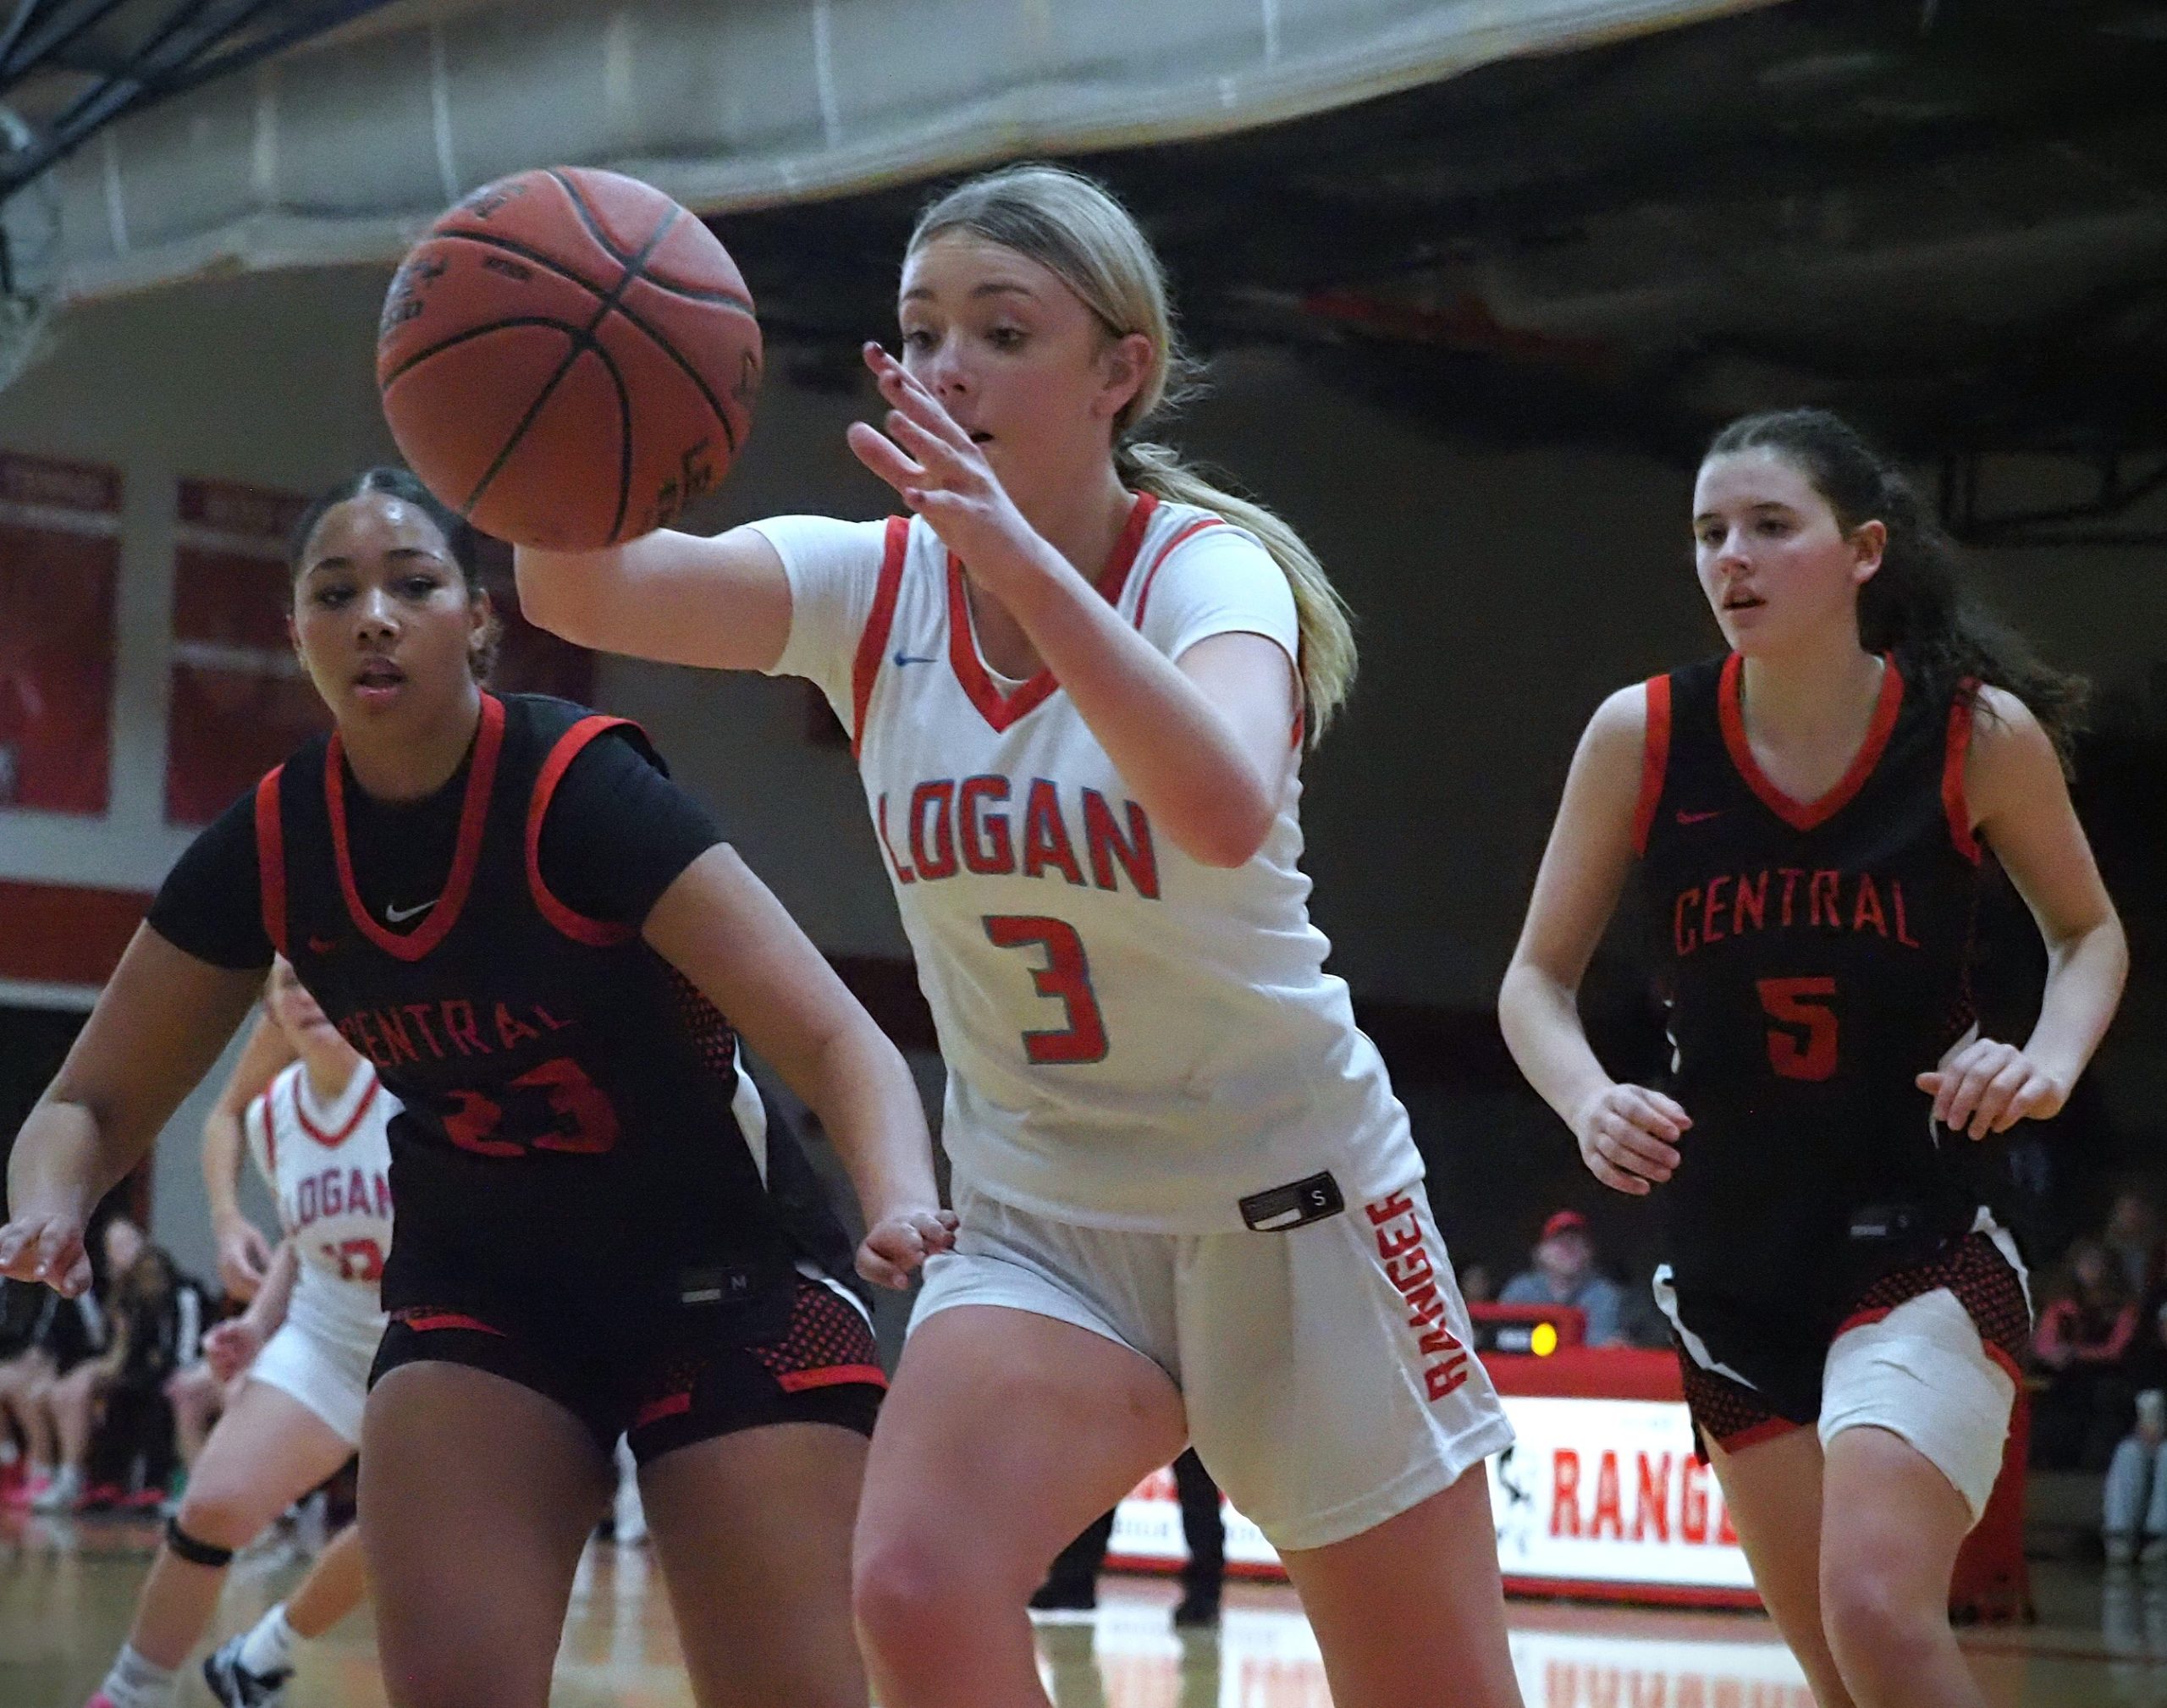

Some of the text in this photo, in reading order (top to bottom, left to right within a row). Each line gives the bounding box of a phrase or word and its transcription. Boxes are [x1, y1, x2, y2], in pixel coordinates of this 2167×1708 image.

[879, 774, 1161, 901] LOGAN
[1673, 869, 1921, 957] CENTRAL
[981, 914, 1109, 1065] 3
[1756, 977, 1839, 1081] 5
[443, 1057, 622, 1157] 23
[1311, 1190, 1326, 1206] S
[731, 1274, 747, 1291] M
